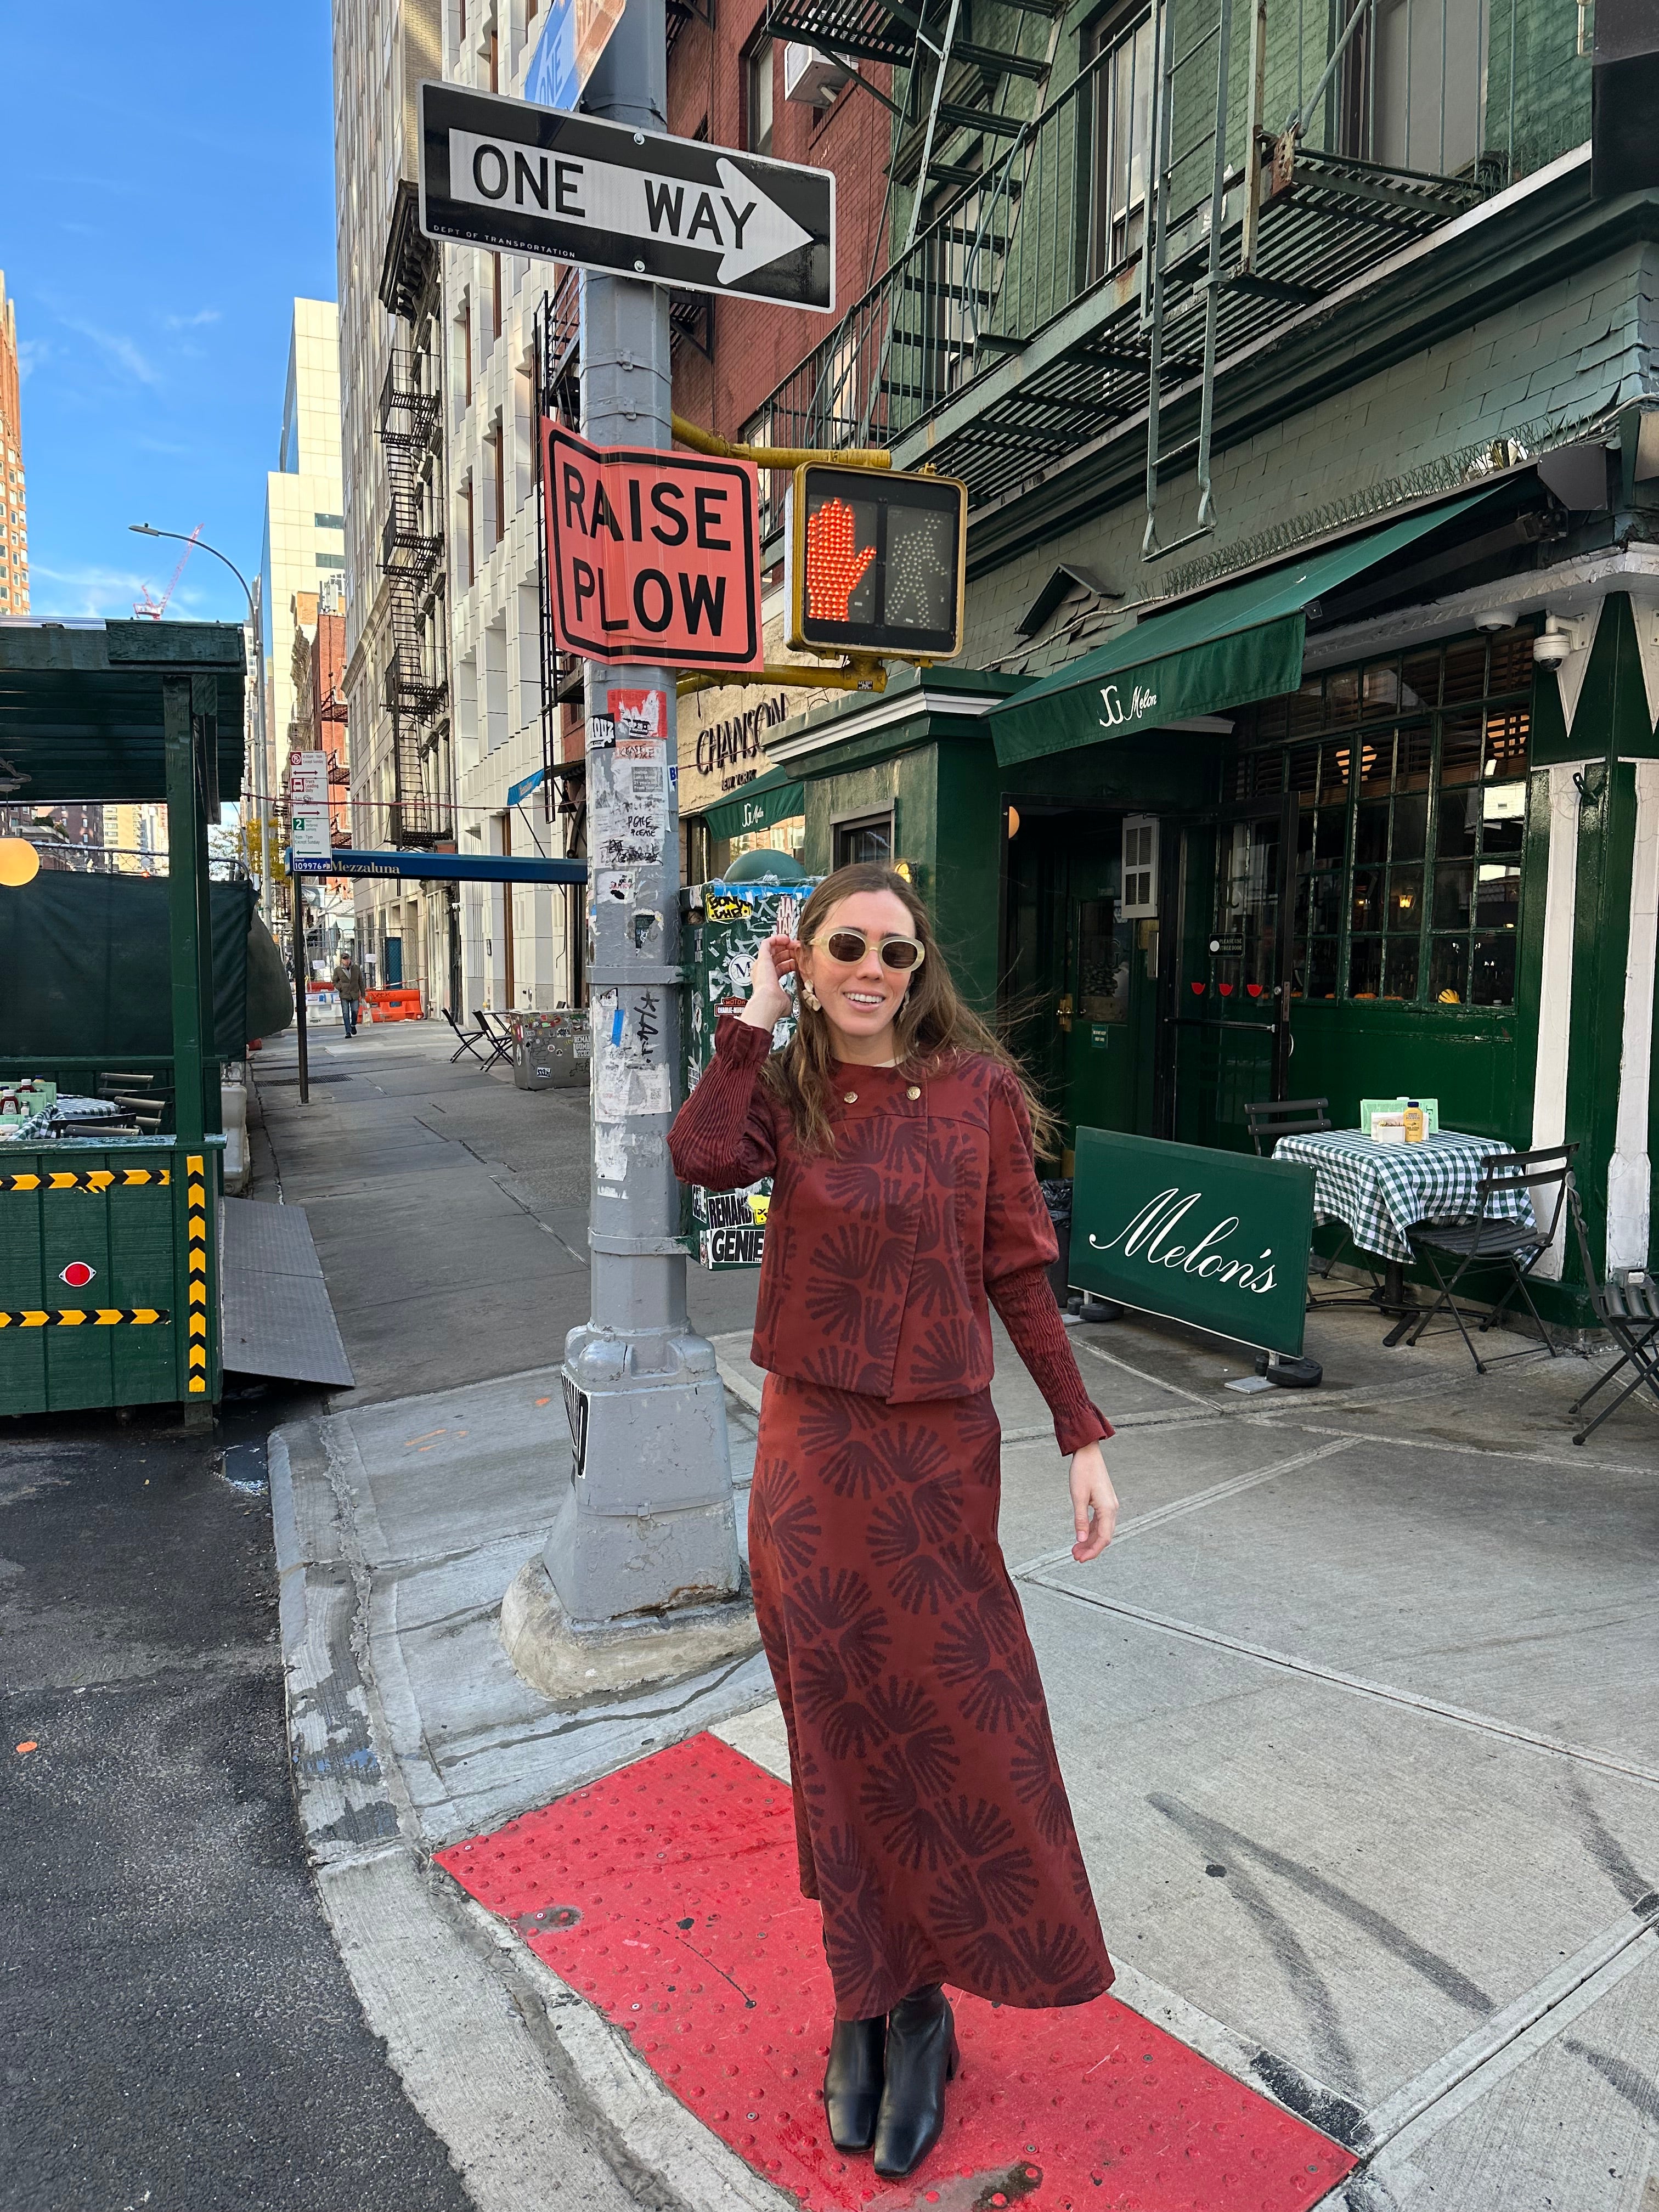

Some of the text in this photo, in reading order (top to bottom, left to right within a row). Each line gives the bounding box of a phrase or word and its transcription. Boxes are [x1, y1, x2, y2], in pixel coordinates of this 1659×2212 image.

[472, 143, 758, 249] ONE WAY
[433, 224, 460, 235] DEPT
[484, 235, 575, 258] TRANSPORTATION
[562, 461, 731, 551] RAISE
[573, 556, 726, 637] PLOW
[1124, 685, 1157, 721] Melon
[696, 692, 786, 775] CHANSON
[721, 769, 757, 791] NEW YORK
[295, 819, 302, 830] 2
[332, 860, 400, 874] Mezzaluna
[712, 1229, 765, 1262] GENIE
[1089, 1188, 1277, 1293] Melon's
